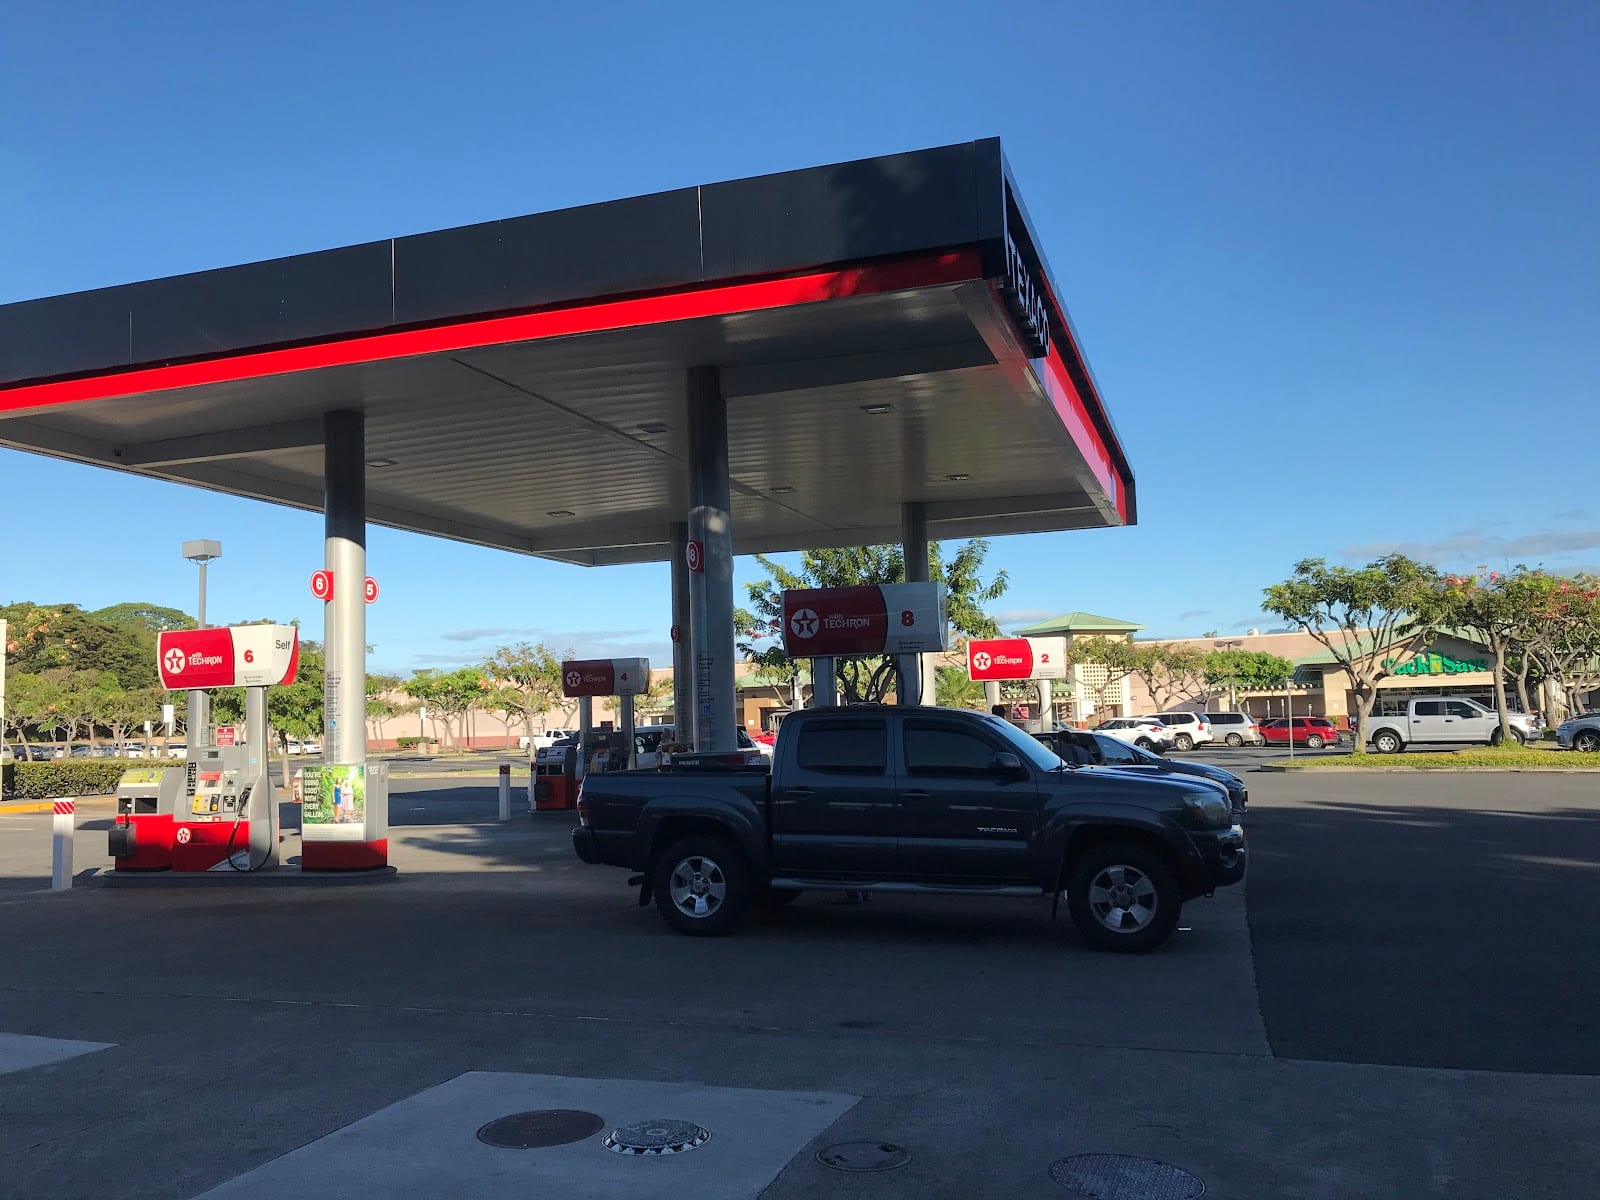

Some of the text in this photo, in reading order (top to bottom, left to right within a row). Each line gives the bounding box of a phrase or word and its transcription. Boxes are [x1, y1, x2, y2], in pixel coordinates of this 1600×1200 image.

[1008, 232, 1050, 357] TEXACO
[315, 577, 324, 590] 6
[366, 583, 374, 596] 5
[823, 617, 870, 630] TECHRON
[901, 610, 914, 627] 8
[275, 639, 290, 651] Self
[187, 655, 223, 666] TECHRON
[243, 649, 254, 663] 6
[993, 657, 1023, 665] TECHRON
[1041, 653, 1050, 664] 2
[620, 672, 628, 681] 4
